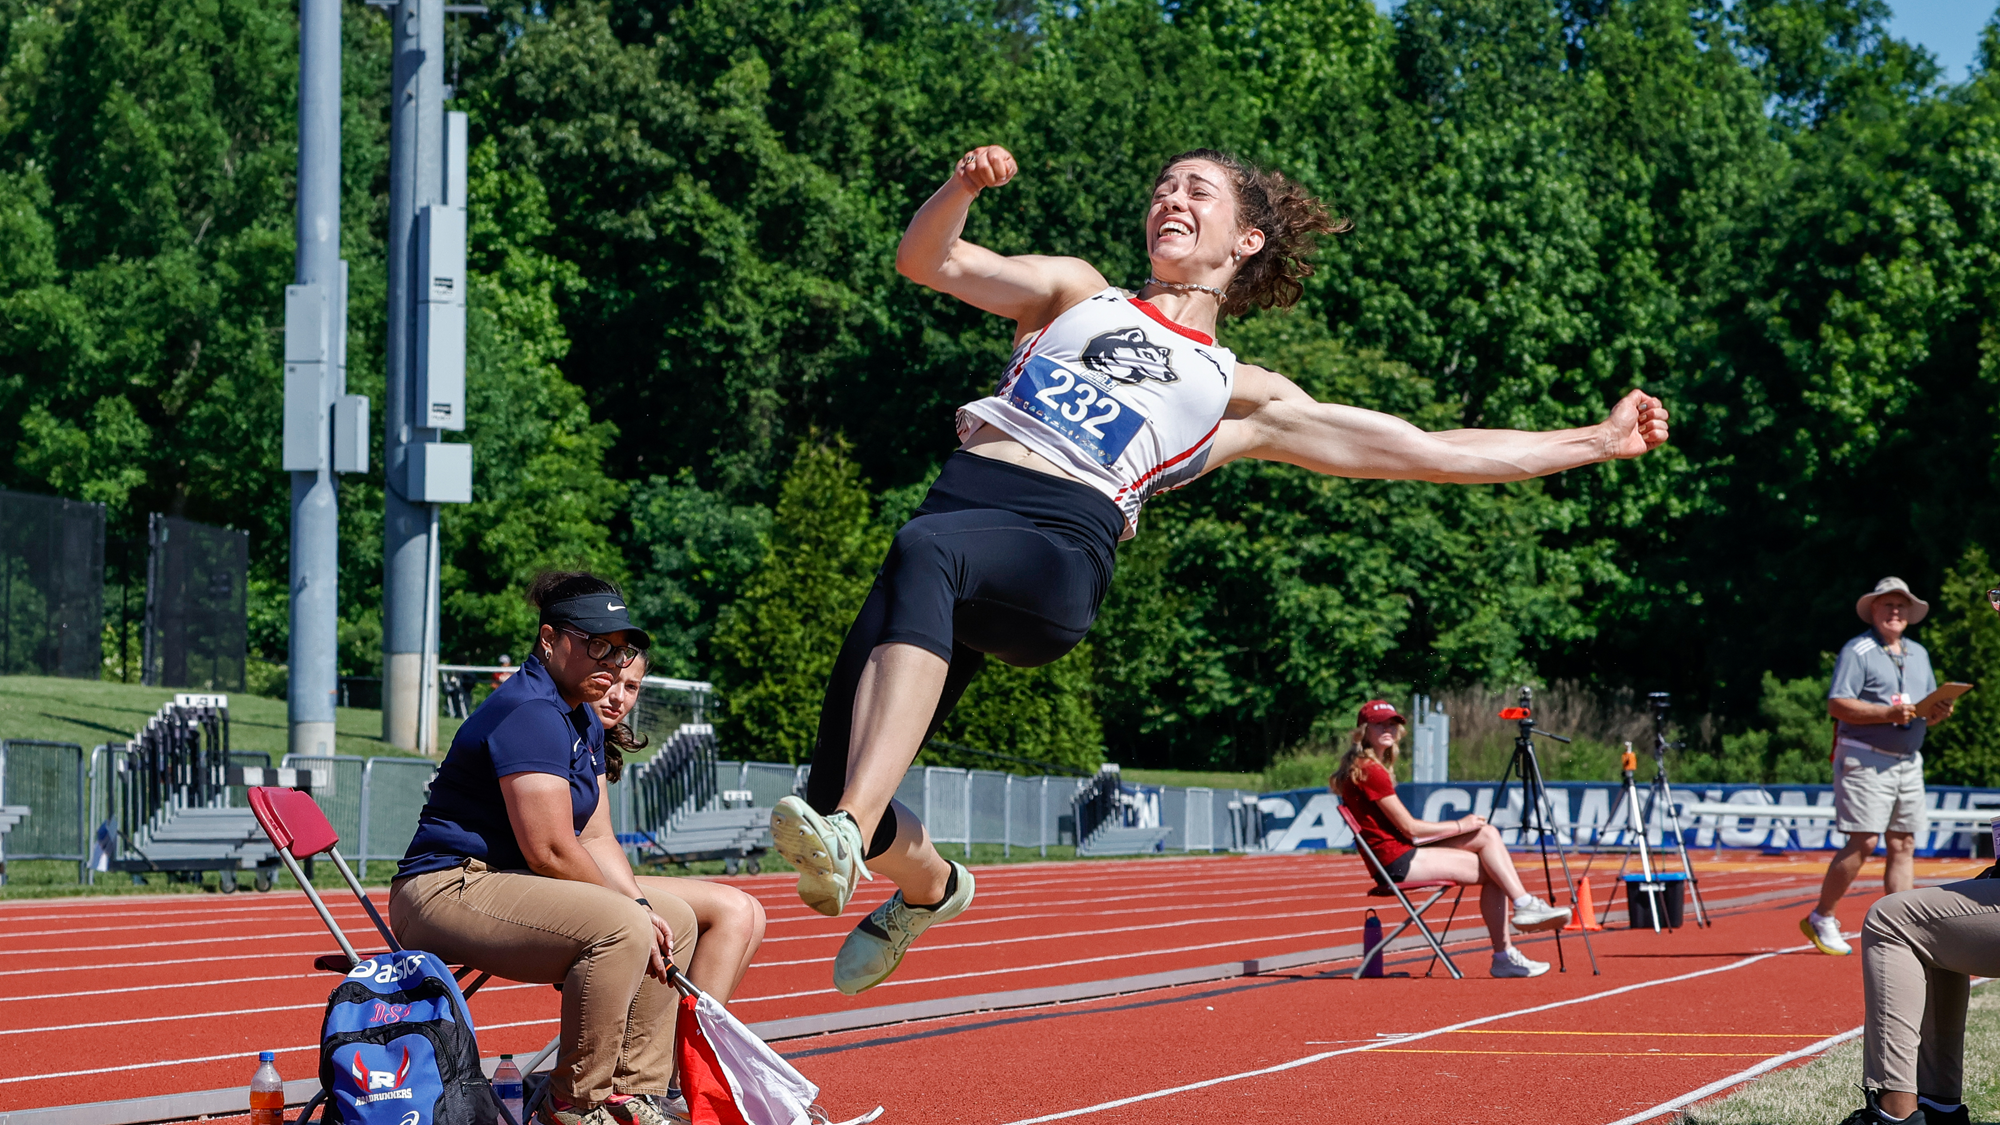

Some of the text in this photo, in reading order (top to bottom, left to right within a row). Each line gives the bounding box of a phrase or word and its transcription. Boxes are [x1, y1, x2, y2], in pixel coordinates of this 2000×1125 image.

[1034, 368, 1121, 440] 232
[369, 1071, 396, 1089] R
[355, 1088, 413, 1106] ROADRUNNERS
